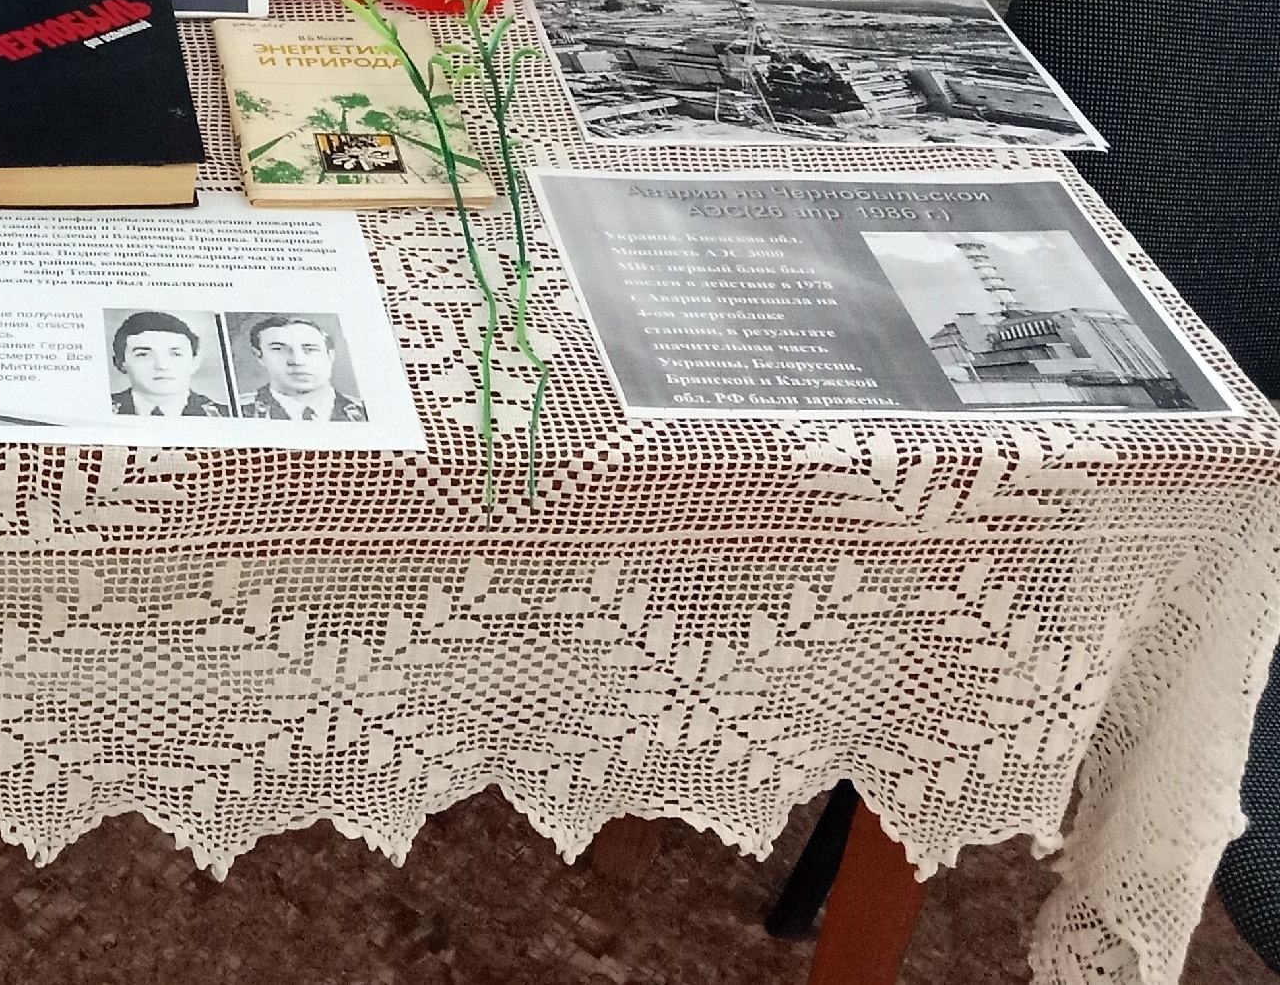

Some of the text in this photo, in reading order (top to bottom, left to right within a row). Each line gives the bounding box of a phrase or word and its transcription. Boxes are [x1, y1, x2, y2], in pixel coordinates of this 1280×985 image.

[253, 44, 395, 55] ЭНЕРГЕТИ
[259, 57, 273, 67] И
[629, 186, 726, 201] Авария
[735, 189, 765, 199] на
[858, 205, 916, 219] 1986
[17, 312, 83, 320] получили
[40, 342, 83, 350] Героя
[66, 353, 93, 361] Все
[1, 363, 80, 371] Митинском
